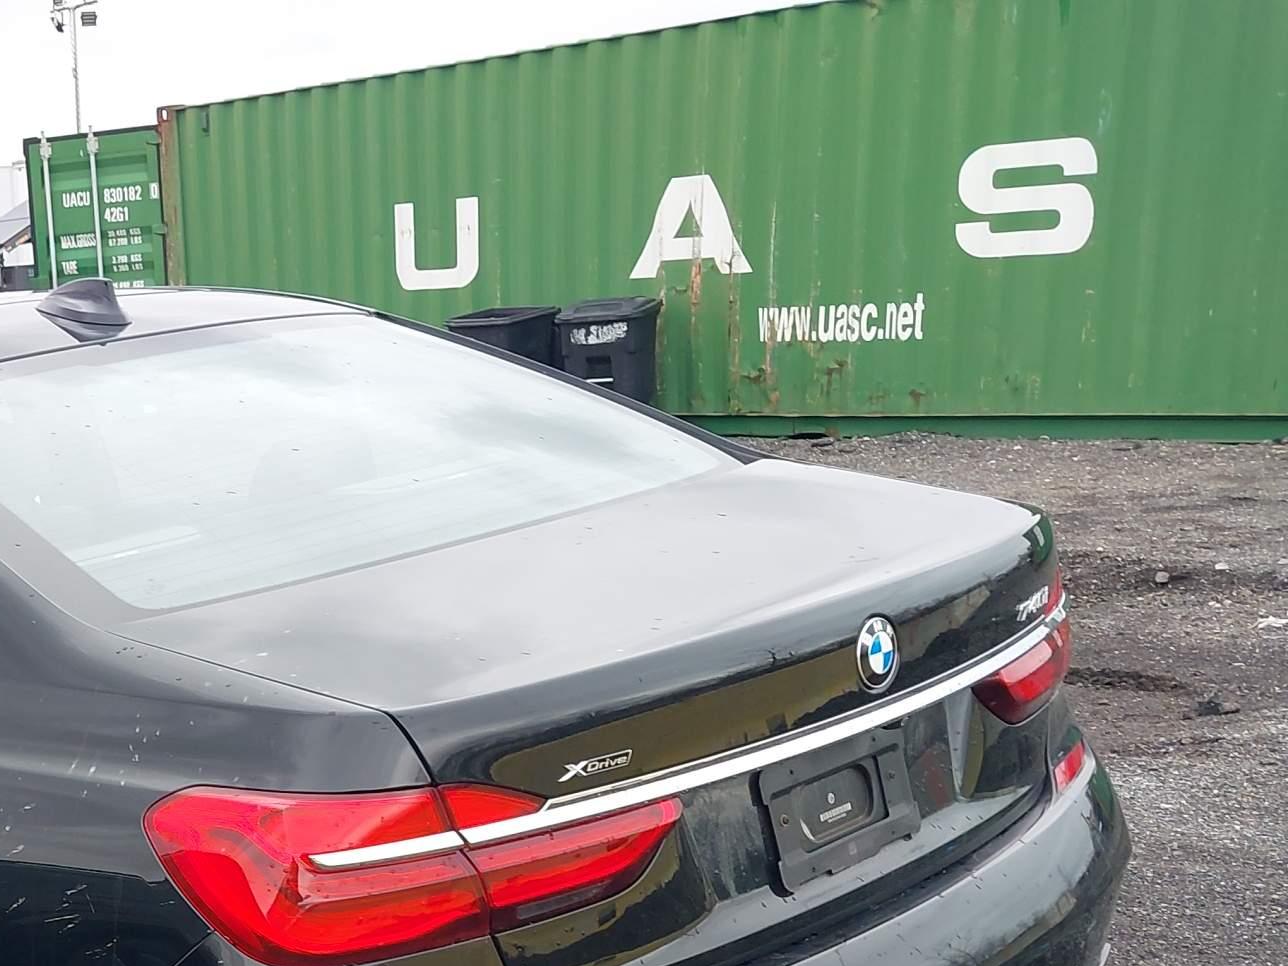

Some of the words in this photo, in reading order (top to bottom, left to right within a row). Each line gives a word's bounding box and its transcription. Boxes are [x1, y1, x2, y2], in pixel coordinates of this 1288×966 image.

[62, 191, 90, 208] UACU
[103, 185, 143, 203] 830182
[104, 206, 129, 222] 42G1
[758, 292, 925, 343] www.uasc.net
